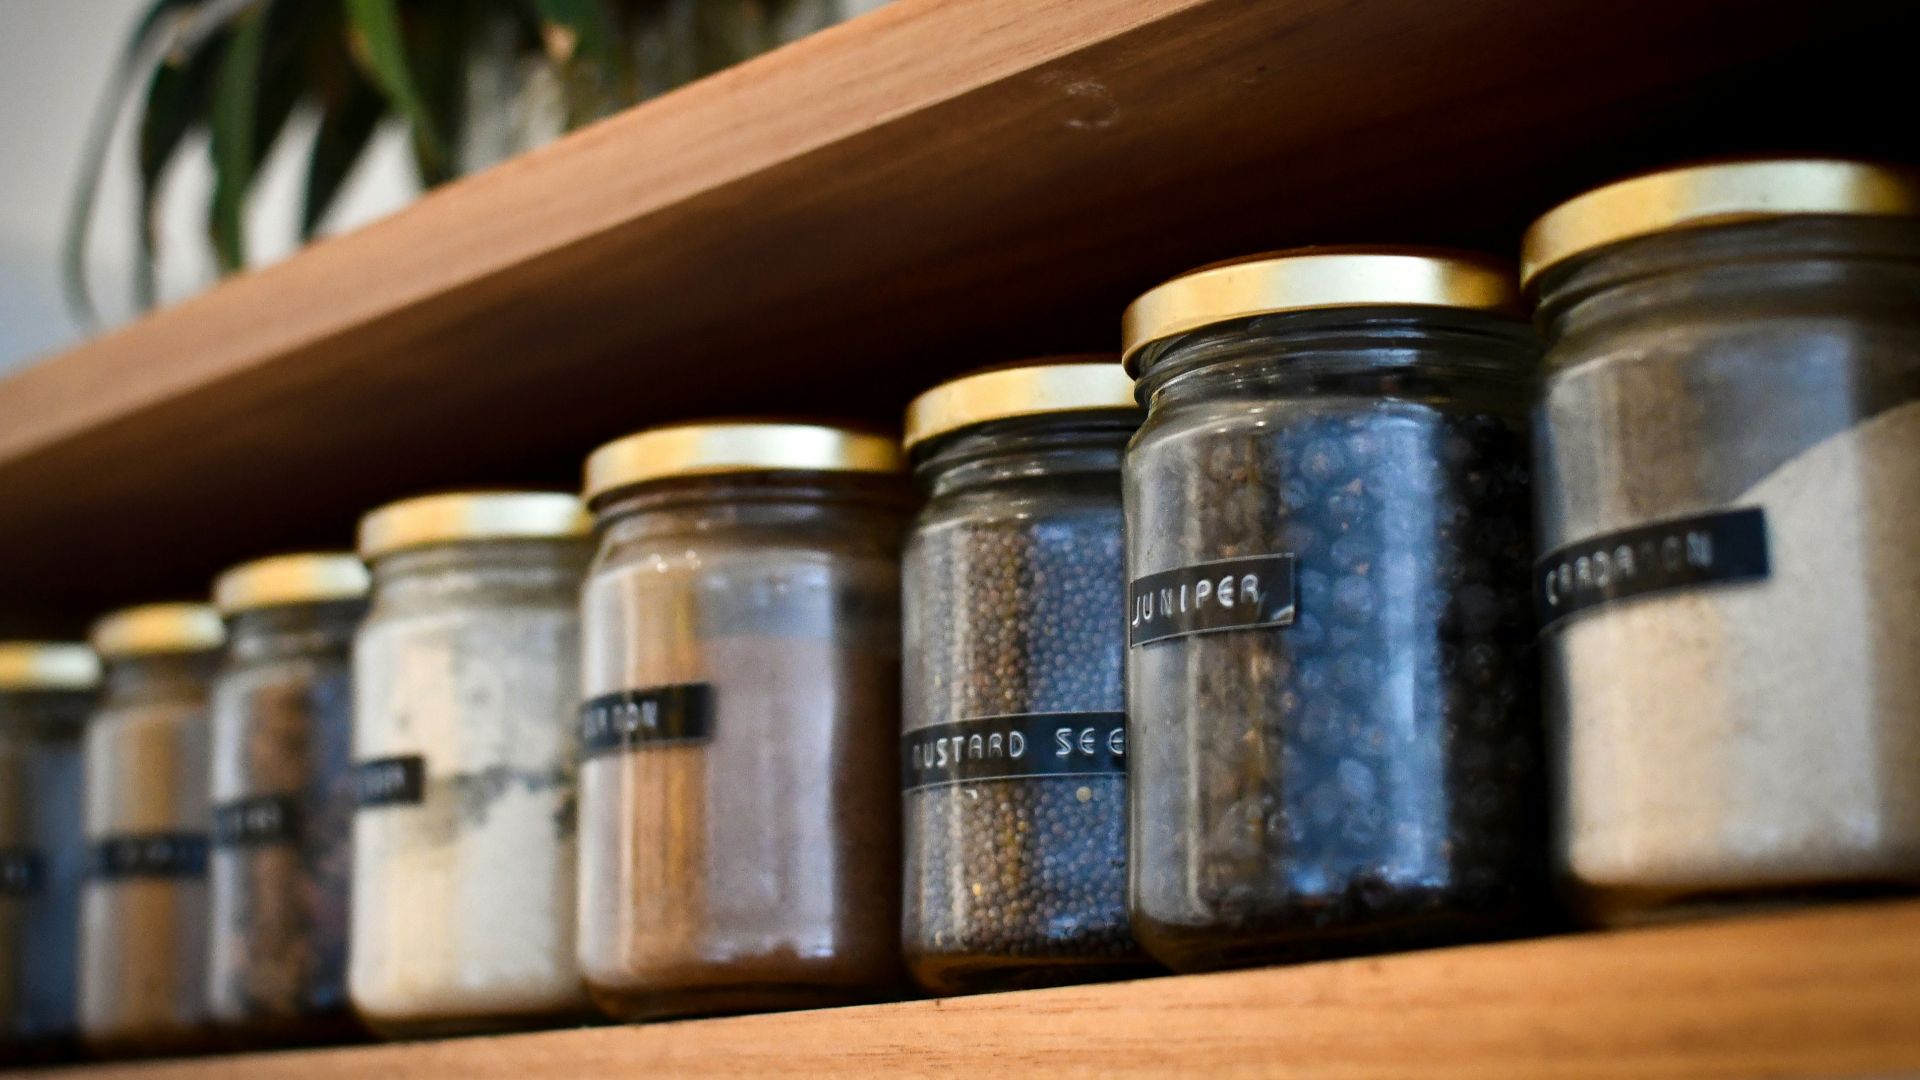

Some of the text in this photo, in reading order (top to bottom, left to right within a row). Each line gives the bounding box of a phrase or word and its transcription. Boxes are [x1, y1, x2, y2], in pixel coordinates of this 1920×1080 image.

[1545, 531, 1714, 606] CARDAON
[1132, 574, 1259, 627] JUNIPER
[912, 730, 1026, 769] MUSTARD
